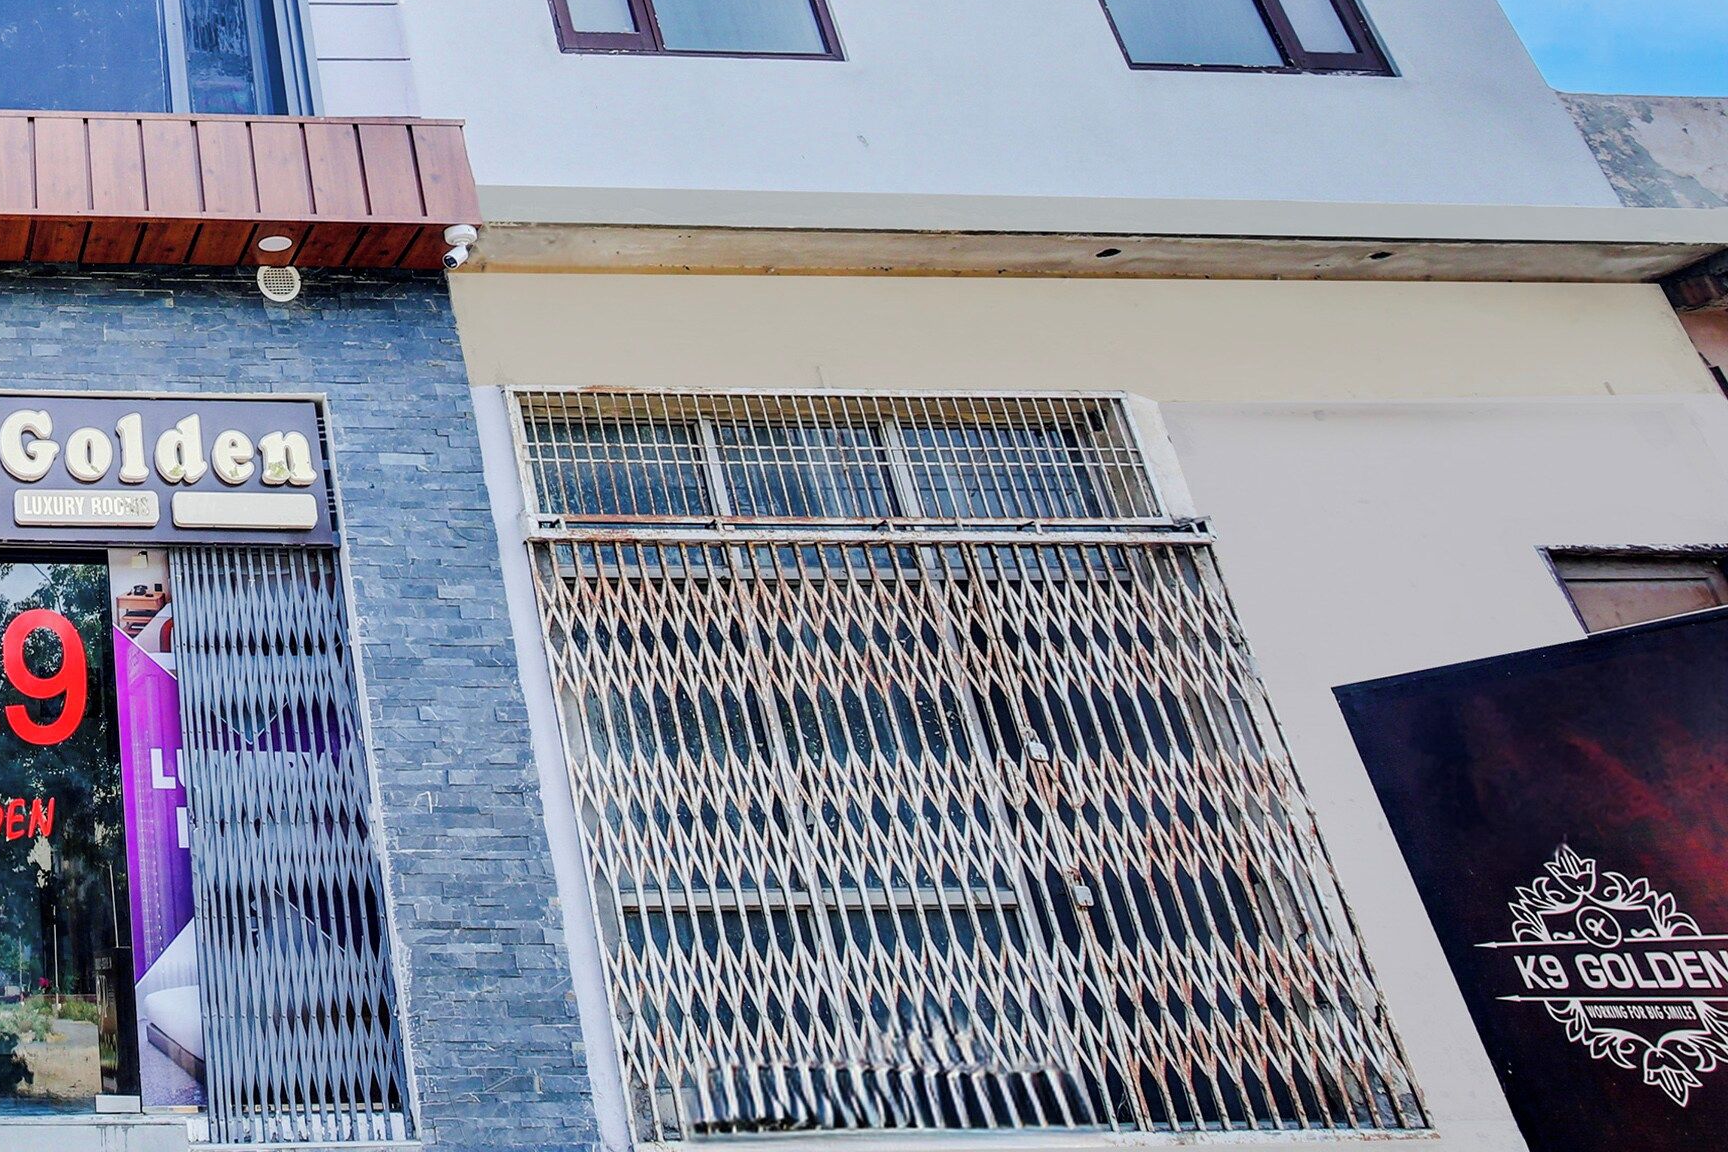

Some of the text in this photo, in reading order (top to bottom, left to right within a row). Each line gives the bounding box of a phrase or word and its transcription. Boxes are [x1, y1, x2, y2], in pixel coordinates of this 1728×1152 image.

[22, 495, 85, 516] LUXURY
[1513, 950, 1728, 990] K9 GOLDEN
[1585, 1004, 1698, 1021] WORKING FOR BIG SMILES
